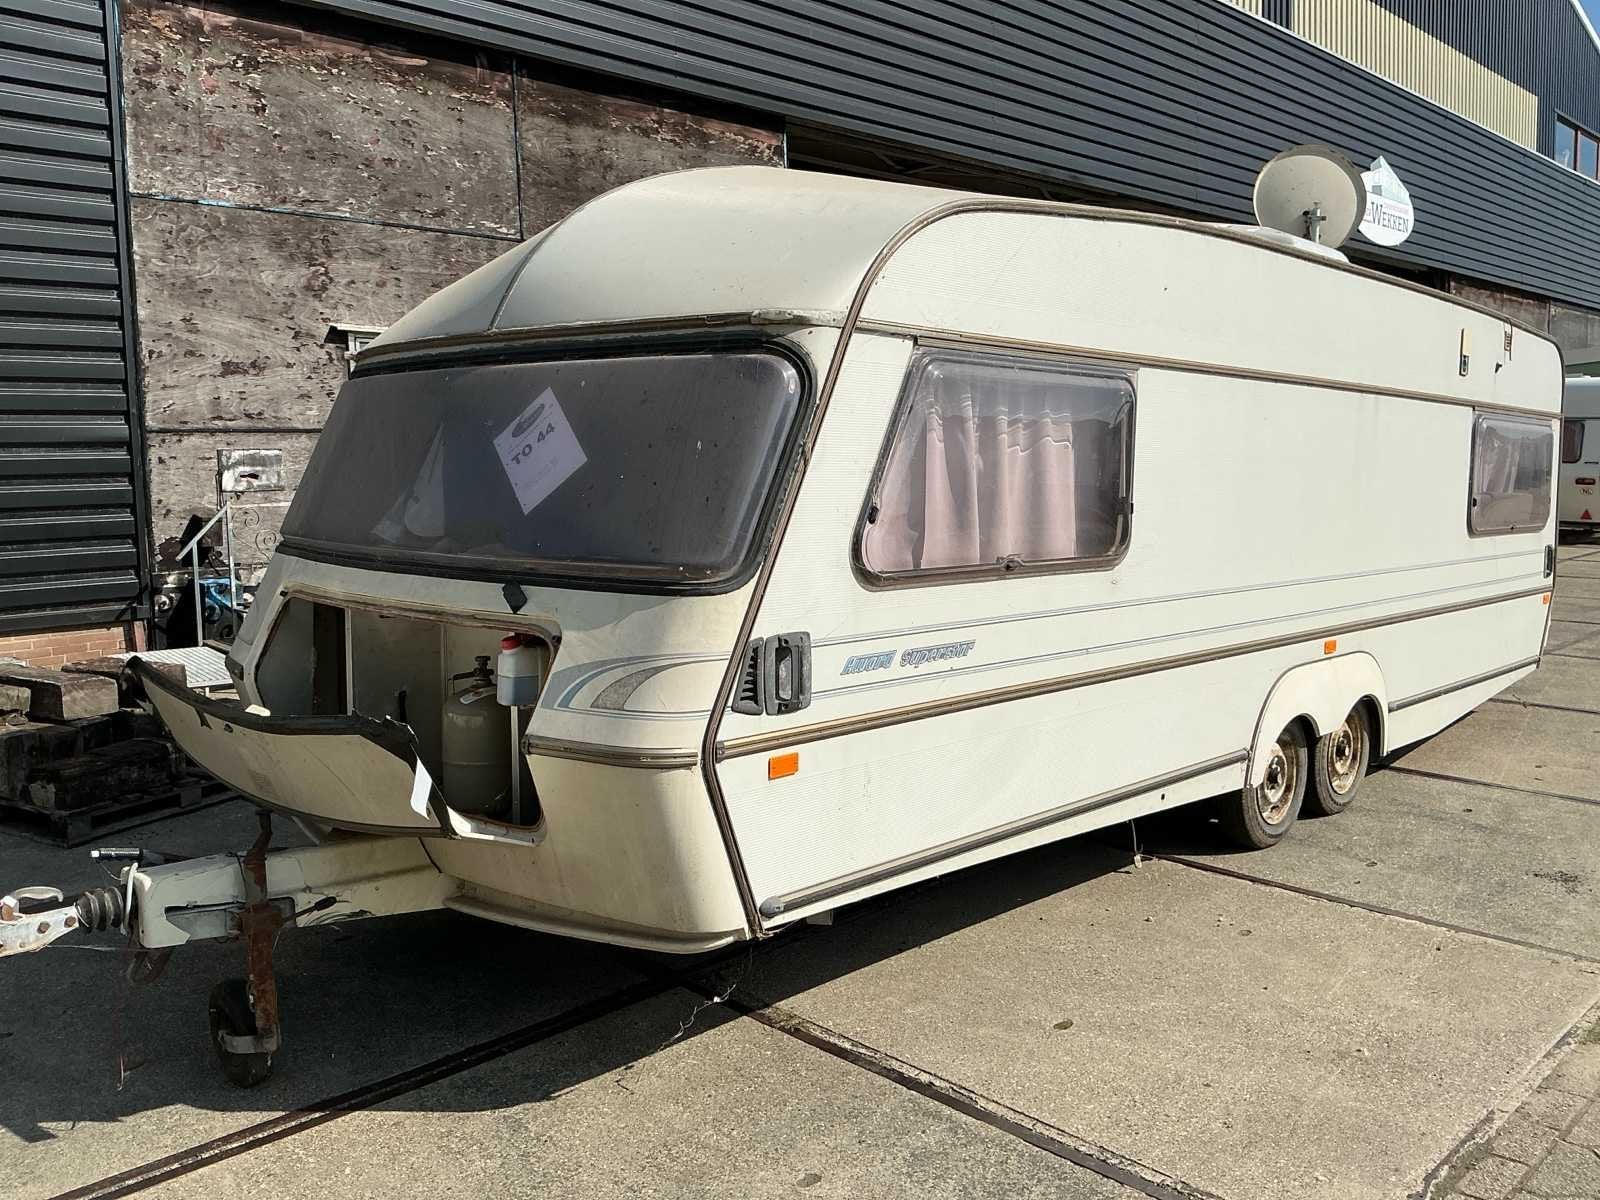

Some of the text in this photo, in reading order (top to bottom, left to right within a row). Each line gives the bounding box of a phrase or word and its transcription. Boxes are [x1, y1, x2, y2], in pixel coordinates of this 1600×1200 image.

[1371, 201, 1409, 233] WEKKEN
[511, 422, 555, 465] TO 44
